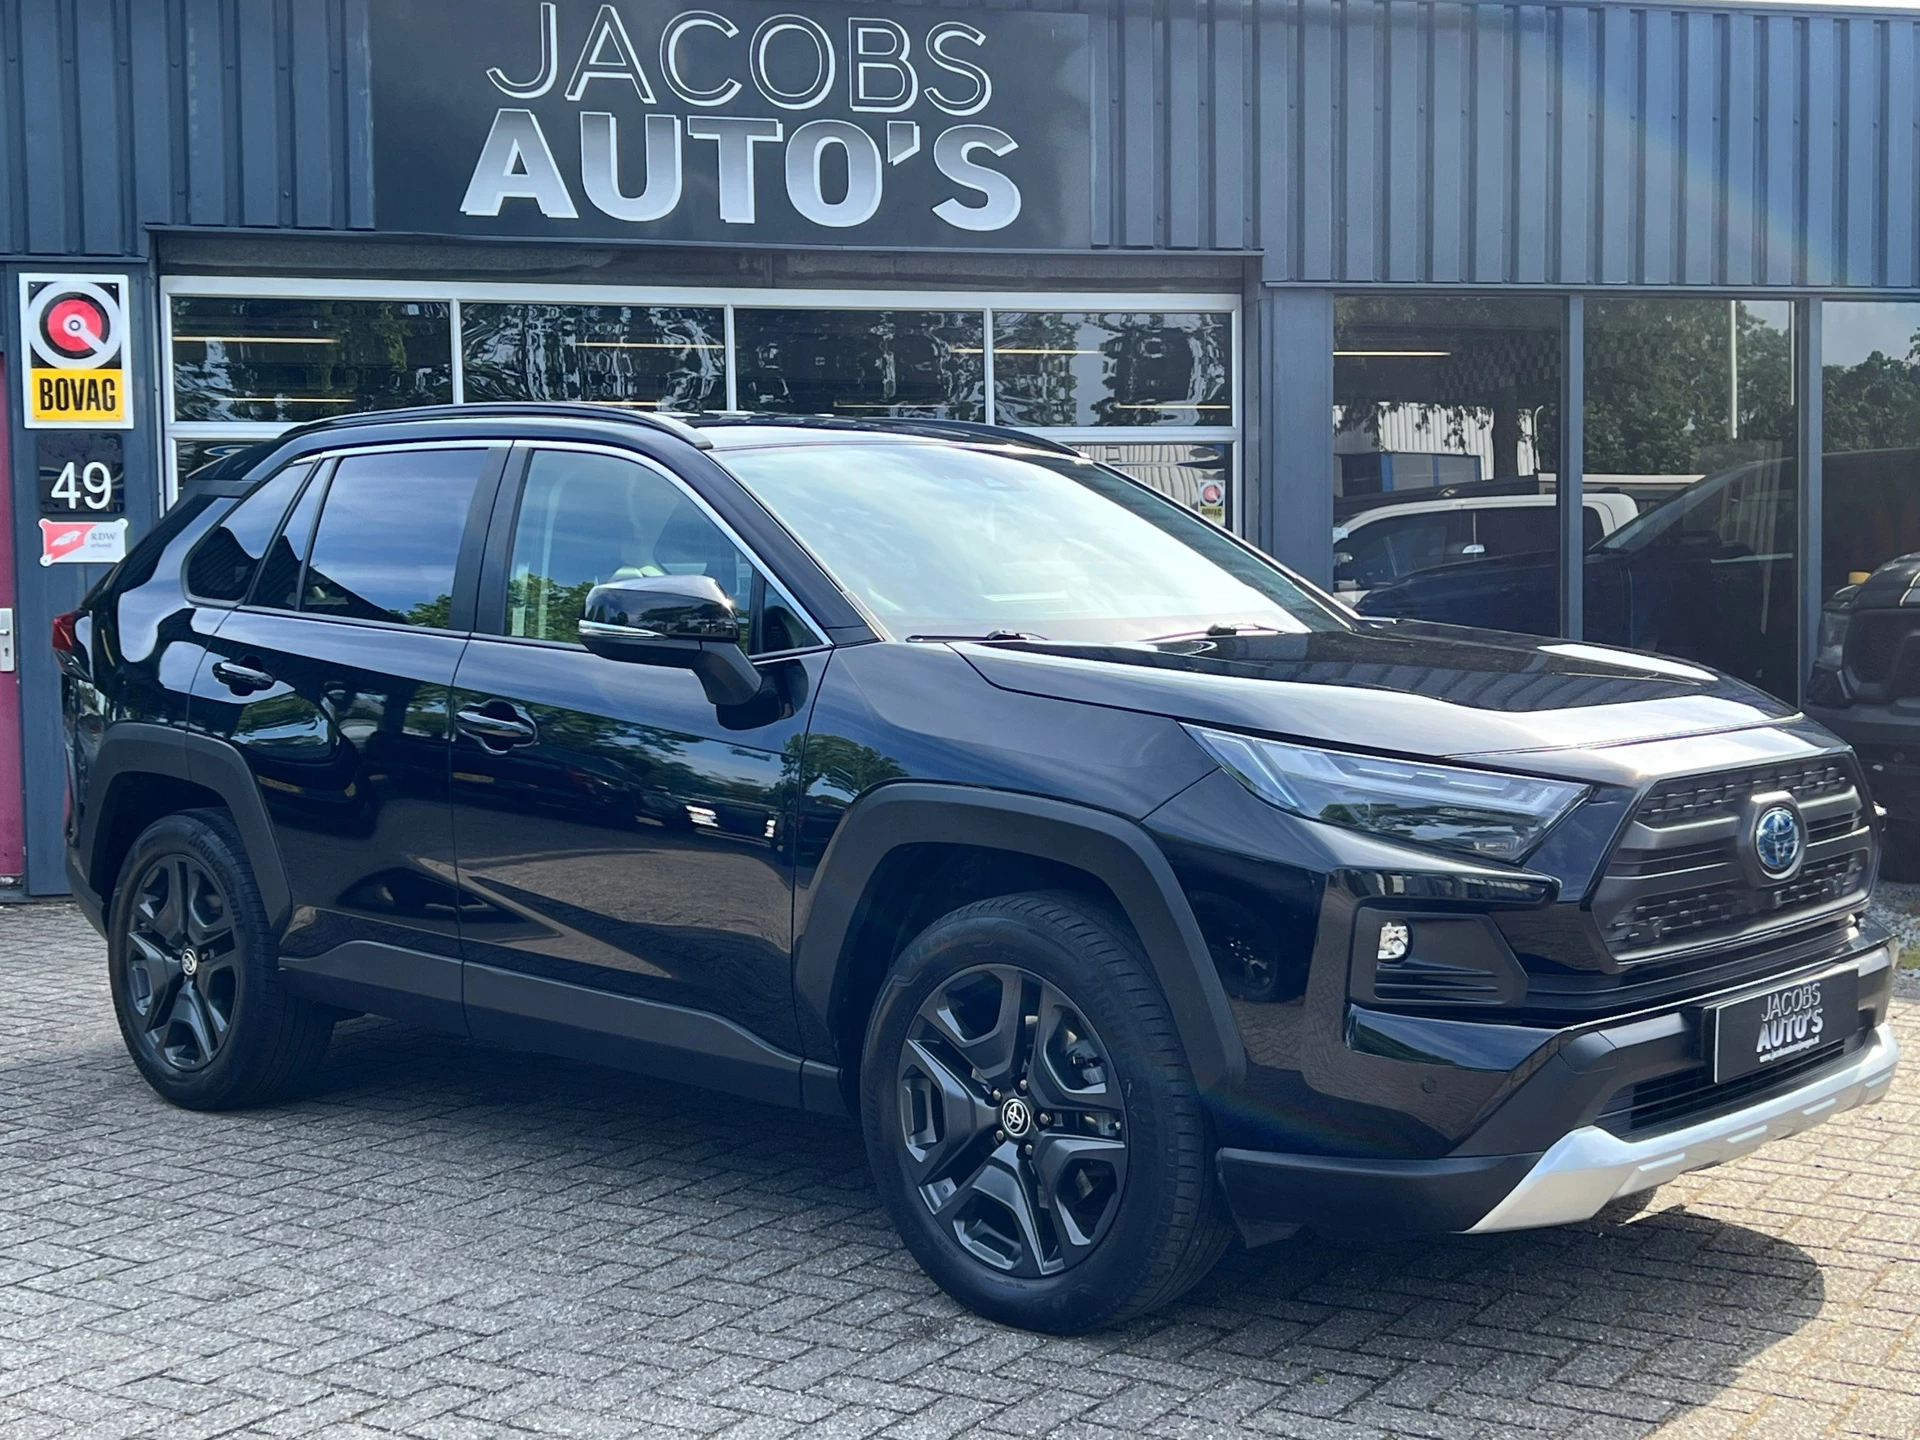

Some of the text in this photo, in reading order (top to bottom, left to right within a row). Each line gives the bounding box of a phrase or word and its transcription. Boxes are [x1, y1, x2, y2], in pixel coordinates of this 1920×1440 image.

[486, 2, 992, 116] JACOBS
[459, 108, 1021, 231] AUTO'S
[39, 377, 117, 412] BOVAG
[51, 461, 112, 510] 49
[1761, 983, 1821, 1022] JACOBS
[1756, 1007, 1824, 1053] AUTO'S
